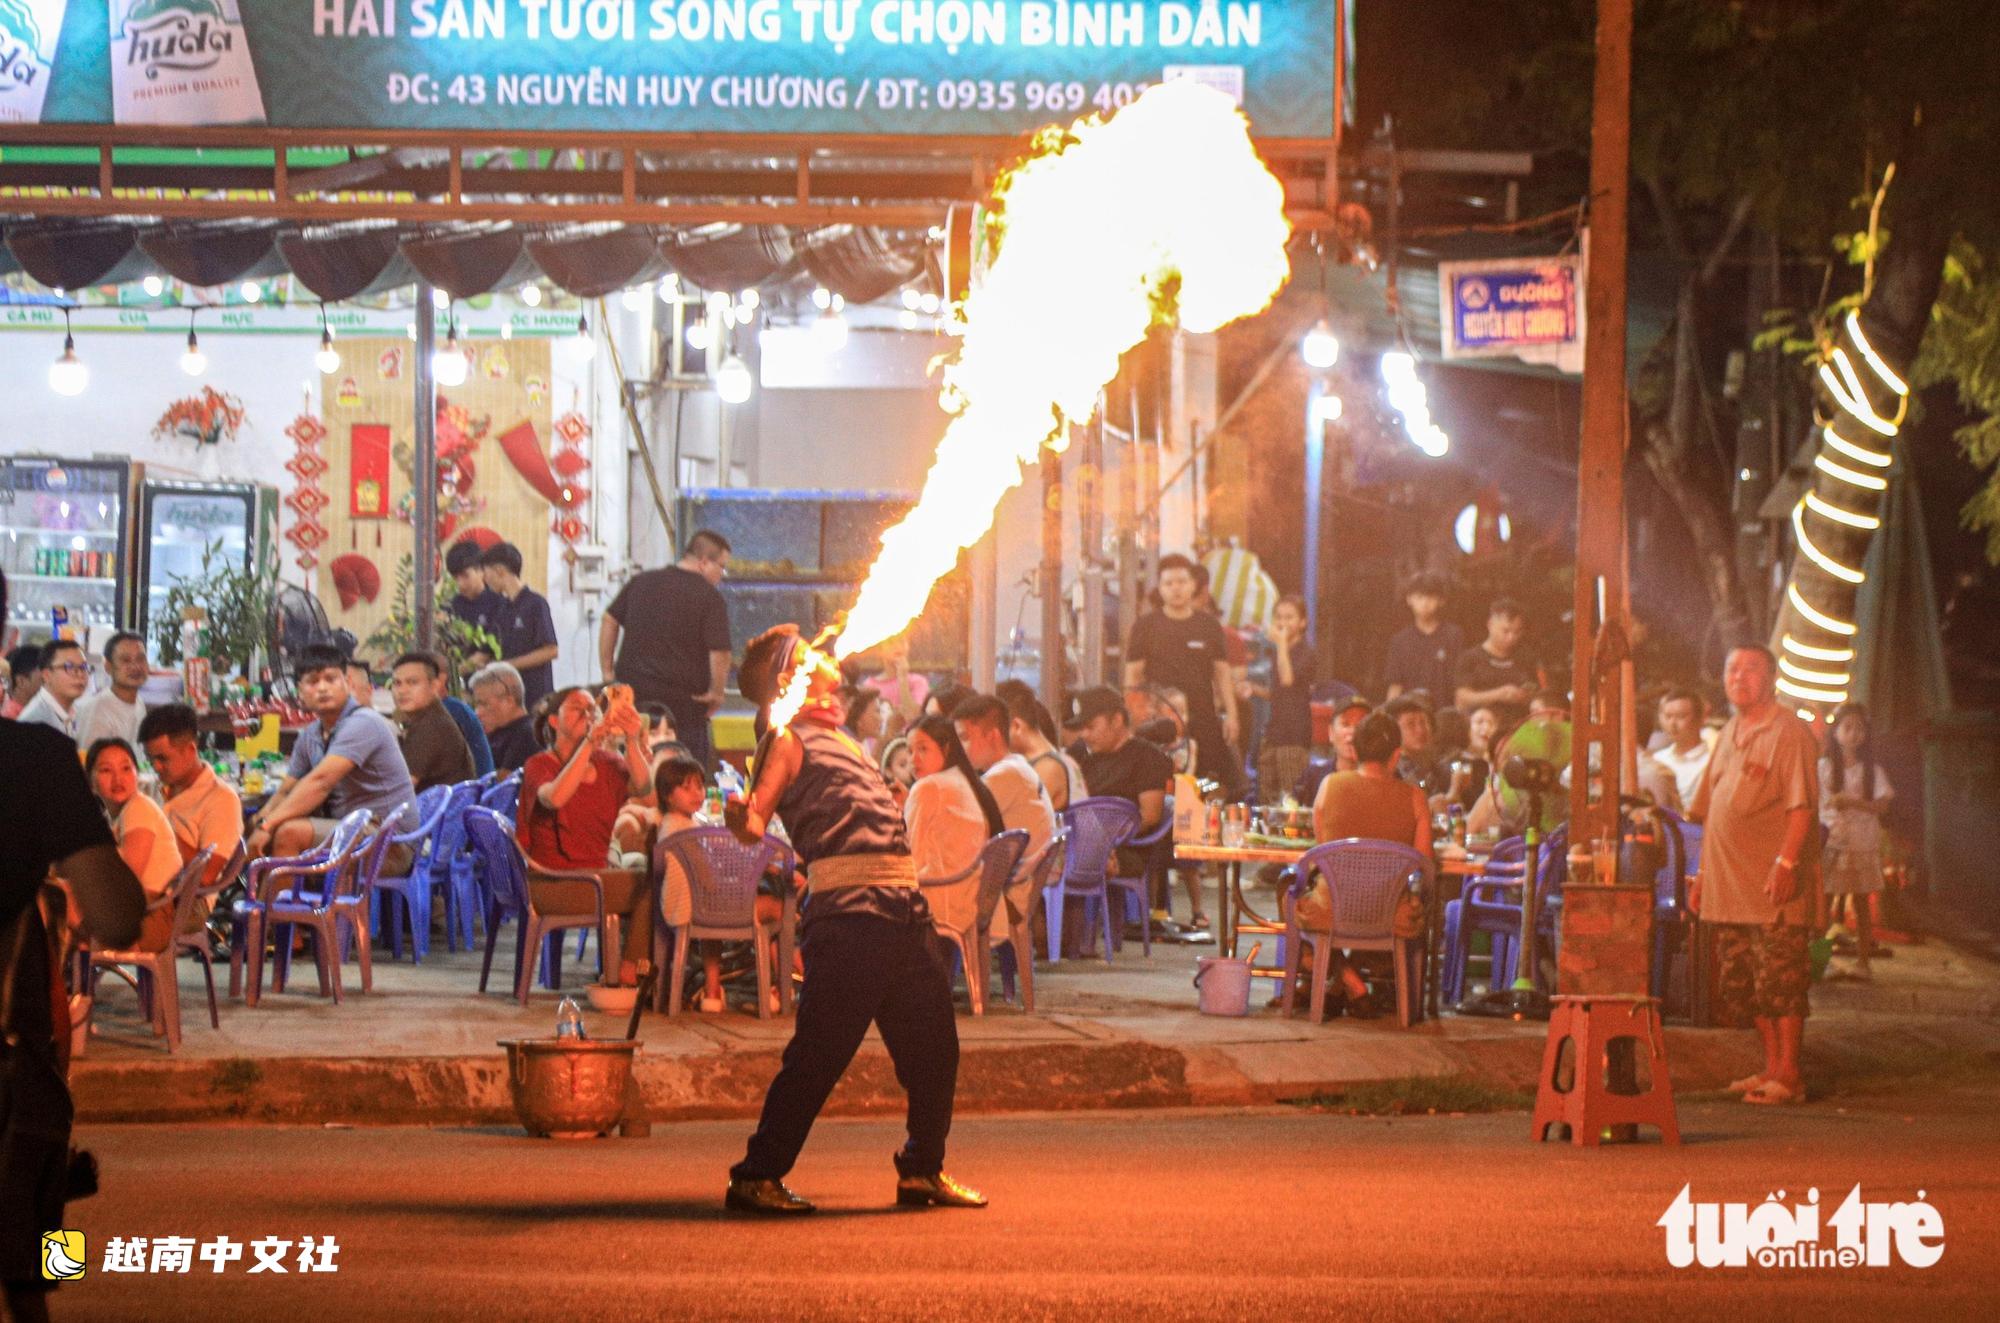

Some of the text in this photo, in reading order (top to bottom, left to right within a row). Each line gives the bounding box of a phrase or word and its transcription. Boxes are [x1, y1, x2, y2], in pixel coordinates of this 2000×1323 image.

[127, 18, 233, 76] huda
[792, 0, 862, 54] TỰ
[870, 0, 1007, 55] CHỌN
[133, 79, 242, 100] PREMIUM QUALITY
[386, 73, 440, 104] ĐC:
[448, 74, 487, 104] 43
[496, 66, 627, 106] NGUYỄN
[636, 75, 704, 106] HUY
[710, 73, 848, 109] CHƯƠNG
[877, 78, 929, 110] ĐT:
[936, 80, 1016, 111] 0935
[1024, 81, 1086, 111] 969
